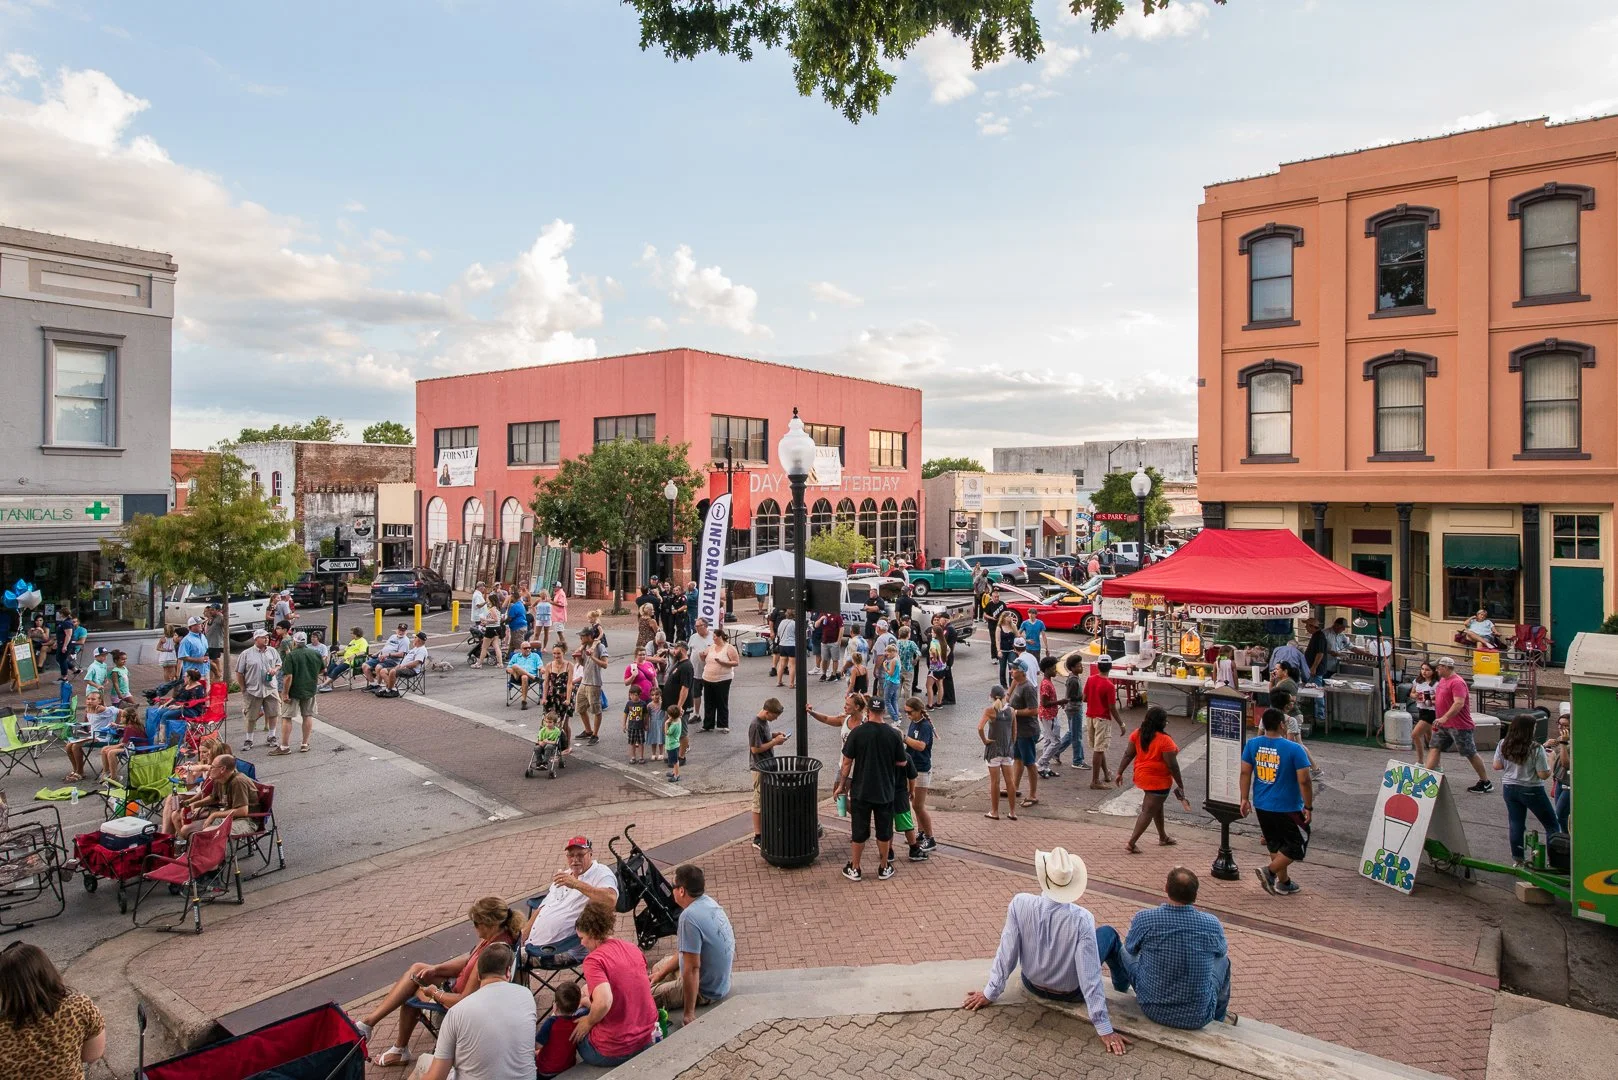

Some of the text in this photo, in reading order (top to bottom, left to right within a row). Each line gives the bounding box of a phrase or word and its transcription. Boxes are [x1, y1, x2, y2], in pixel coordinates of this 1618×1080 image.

[443, 451, 456, 460] FOR
[811, 476, 900, 492] TERDAY
[702, 521, 723, 627] INFORMATION
[1132, 597, 1164, 606] CORN DOGS
[1189, 605, 1308, 615] FOOTLONG CORNDOG
[1257, 766, 1277, 783] DIE
[1383, 766, 1439, 798] SHAVED
[1396, 778, 1422, 799] ICE
[1375, 848, 1411, 872] COLD
[1363, 860, 1415, 890] DRINKS
